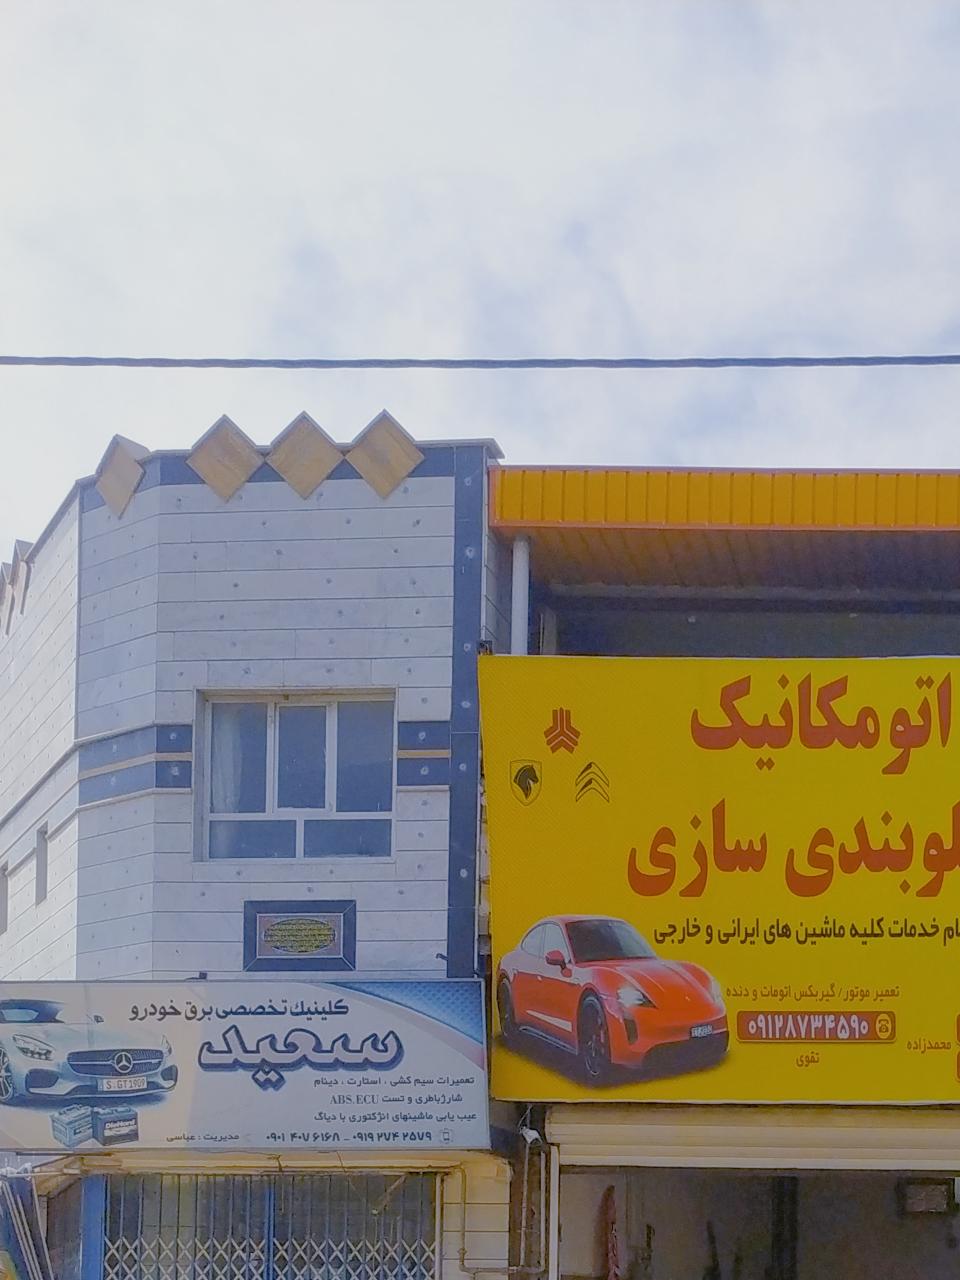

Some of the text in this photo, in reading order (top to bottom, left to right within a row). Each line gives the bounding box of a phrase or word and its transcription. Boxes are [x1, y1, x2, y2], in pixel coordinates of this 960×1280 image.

[627, 797, 768, 897] سازی
[653, 917, 701, 945] خارجی
[705, 928, 713, 945] و
[717, 917, 760, 946] ایرانی
[763, 918, 791, 944] های
[796, 916, 845, 945] ماشین
[849, 917, 884, 945] کلیه
[887, 917, 940, 940] خدمات
[726, 985, 750, 998] دنده
[752, 989, 757, 1001] و
[760, 984, 791, 1000] اتومات
[872, 985, 900, 1003] تعمیر
[128, 1000, 183, 1021] خودرو
[184, 1001, 214, 1021] برق
[216, 1000, 288, 1017] تخصصی
[748, 1013, 869, 1040] ۰۹۱۲۸۷۳۴۵۹۰
[906, 1037, 952, 1054] محمدزاده
[198, 1024, 404, 1091] سعید
[796, 1051, 820, 1068] تقوی
[313, 1077, 339, 1088] دینام
[413, 1077, 434, 1087] سیم
[436, 1076, 475, 1088] تعمیرات
[381, 1094, 405, 1103] تست
[349, 1112, 390, 1123] انژکتوری
[456, 1112, 477, 1122] عیب
